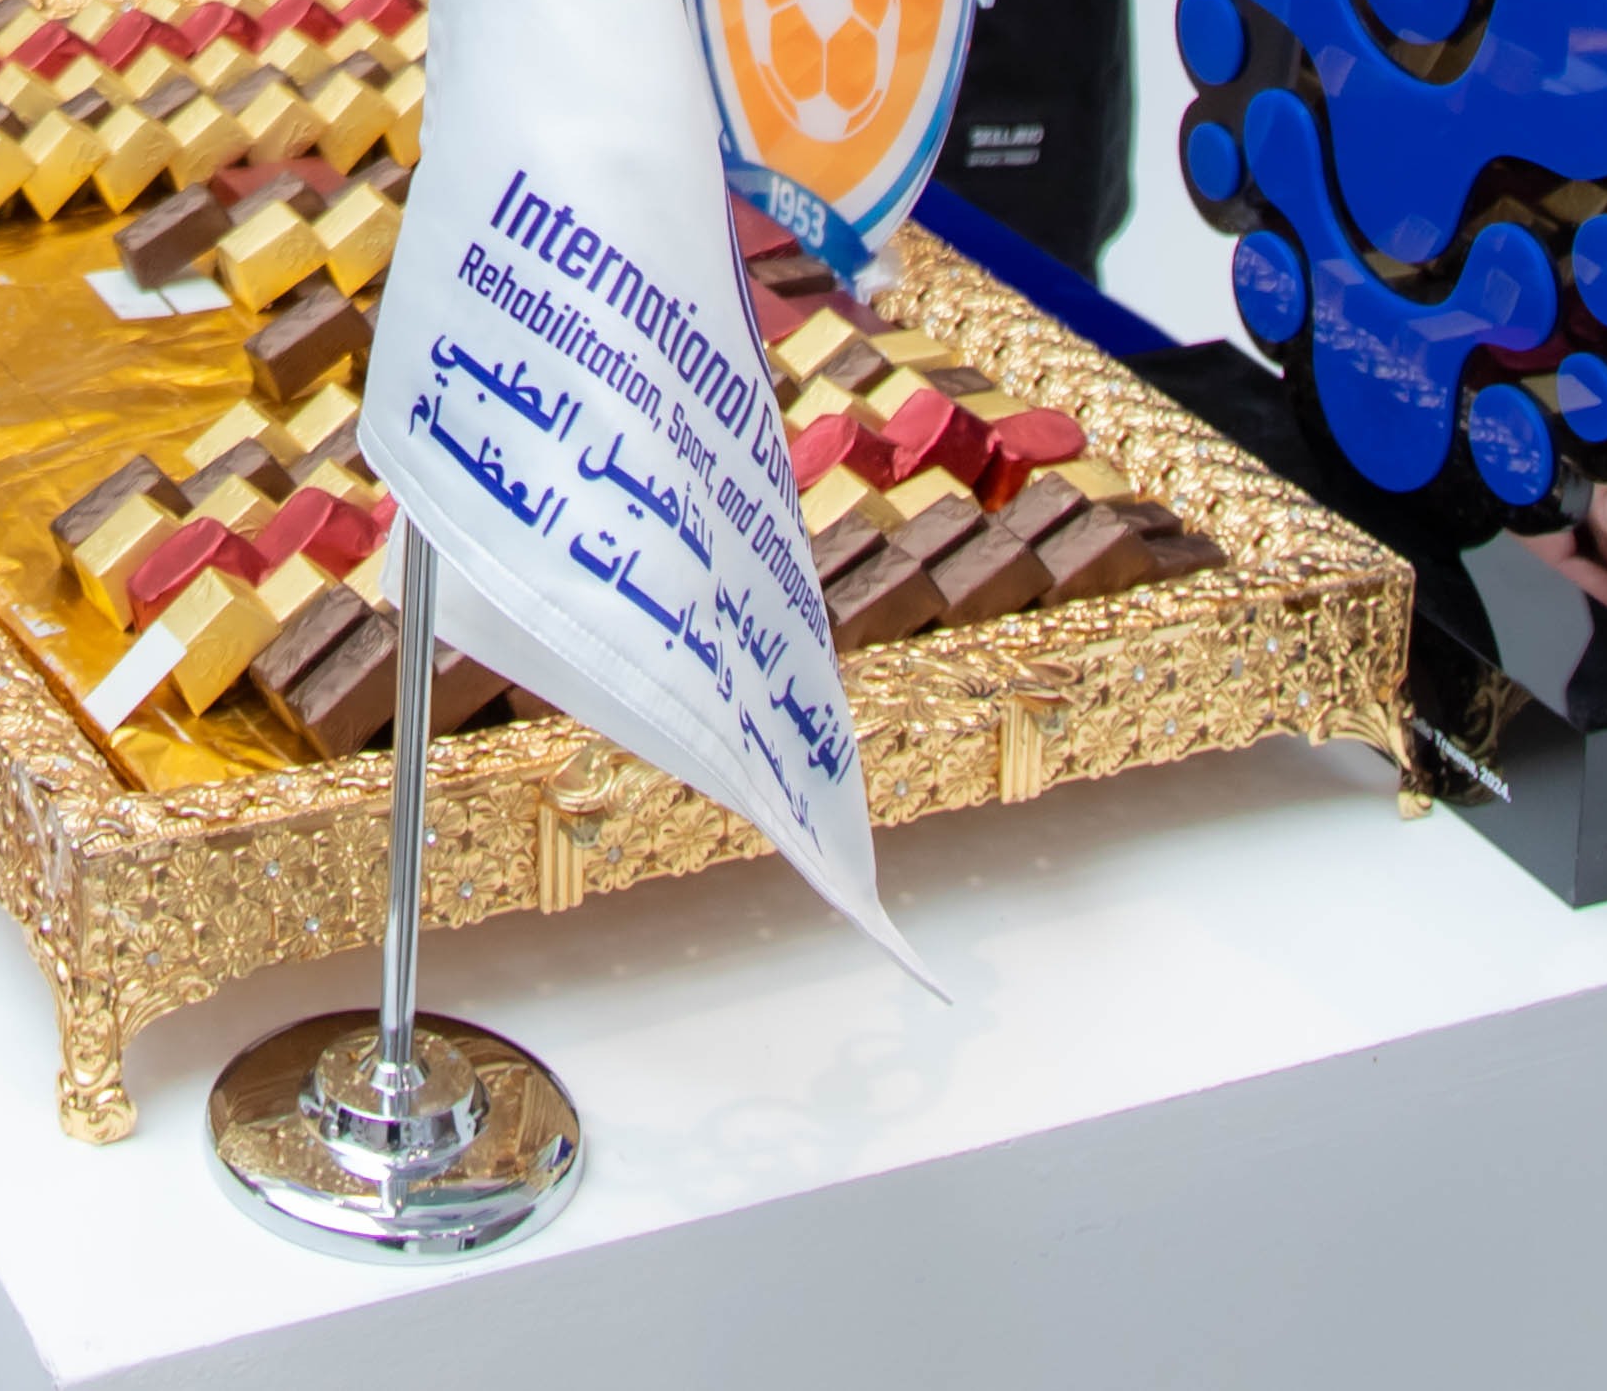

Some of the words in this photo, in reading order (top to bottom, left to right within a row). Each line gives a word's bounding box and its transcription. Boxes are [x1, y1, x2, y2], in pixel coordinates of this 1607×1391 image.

[768, 175, 827, 248] 1953
[490, 169, 758, 439] International
[431, 334, 583, 443] الطبي
[458, 242, 663, 433] Rehabilitation,
[668, 401, 718, 500] Sport,
[716, 476, 764, 536] and
[750, 513, 828, 649] Orthopedic
[409, 394, 569, 538] العظام
[577, 432, 714, 571] للتأهيل
[569, 530, 733, 703] وإصابات
[714, 577, 790, 681] الدولي
[769, 674, 856, 786] المؤتمر
